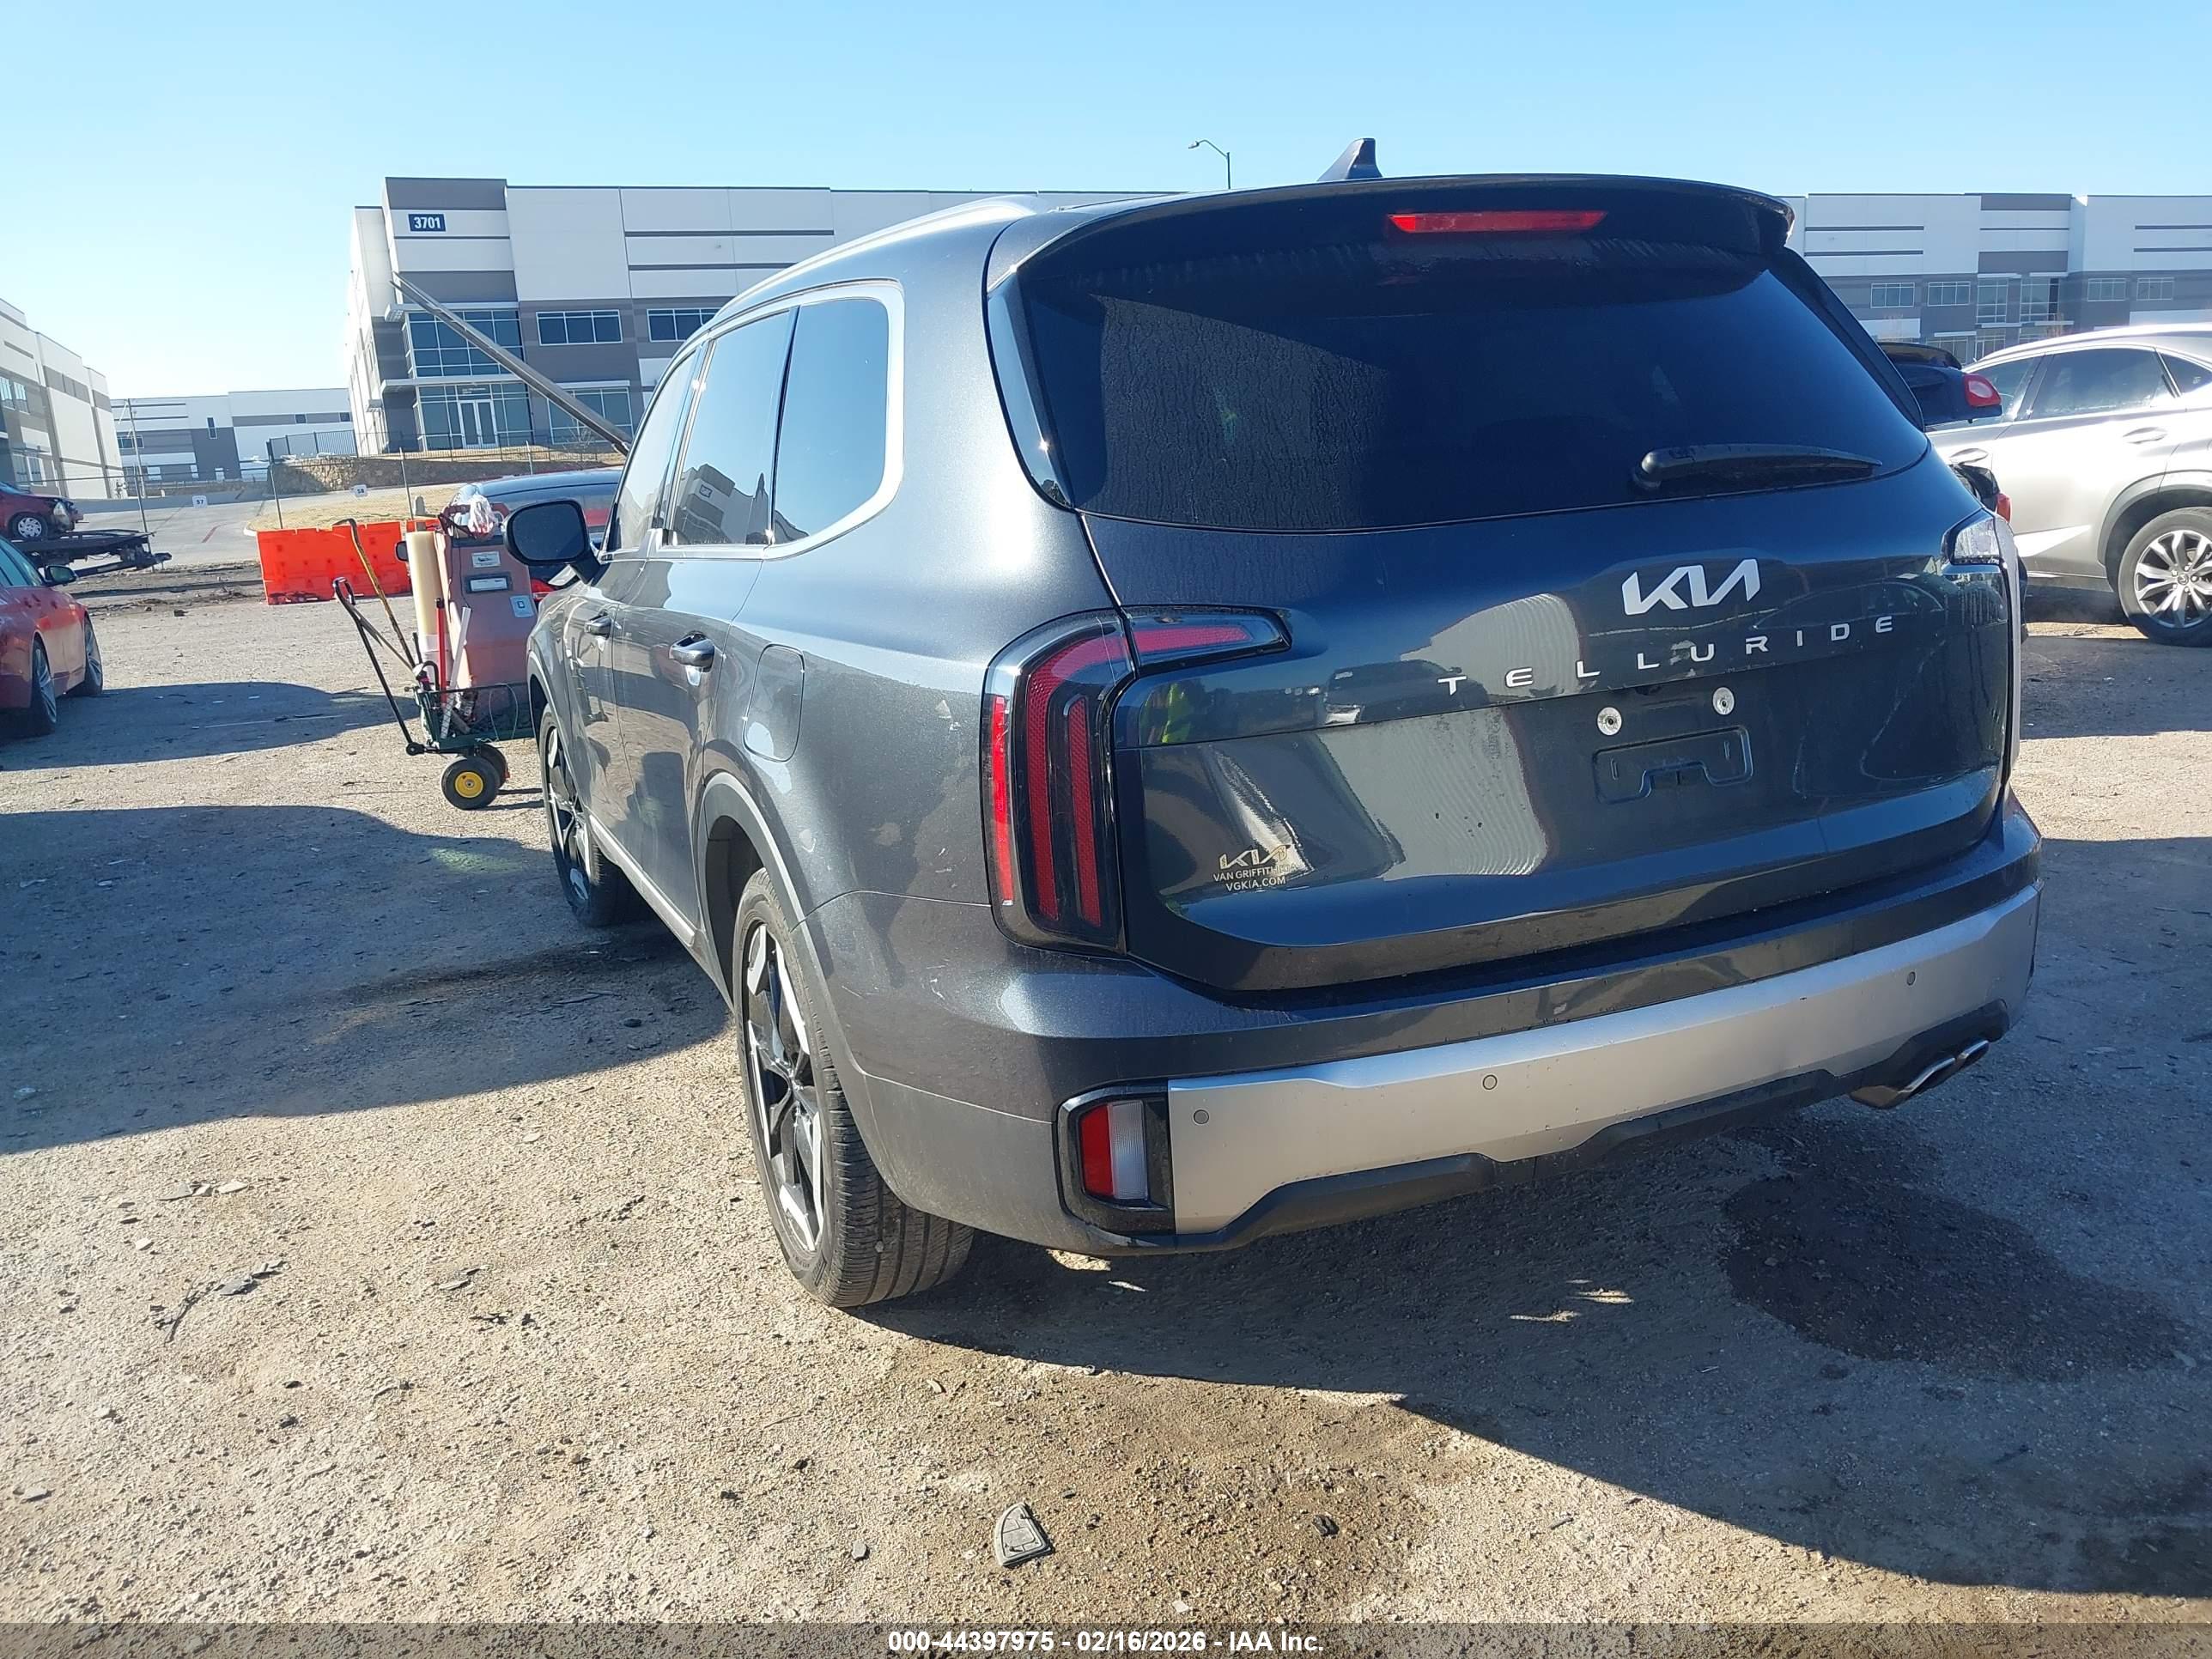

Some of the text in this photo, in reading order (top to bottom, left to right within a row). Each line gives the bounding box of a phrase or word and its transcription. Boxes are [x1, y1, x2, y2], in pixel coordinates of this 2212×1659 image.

[414, 216, 441, 229] 3701
[1621, 558, 1760, 616] KIA
[1437, 616, 1893, 696] TELLURIDE
[1219, 845, 1288, 869] KIA
[1212, 872, 1234, 882] VAN
[1235, 865, 1279, 879] GRIFFITH
[1225, 876, 1286, 891] VGKIA.COM
